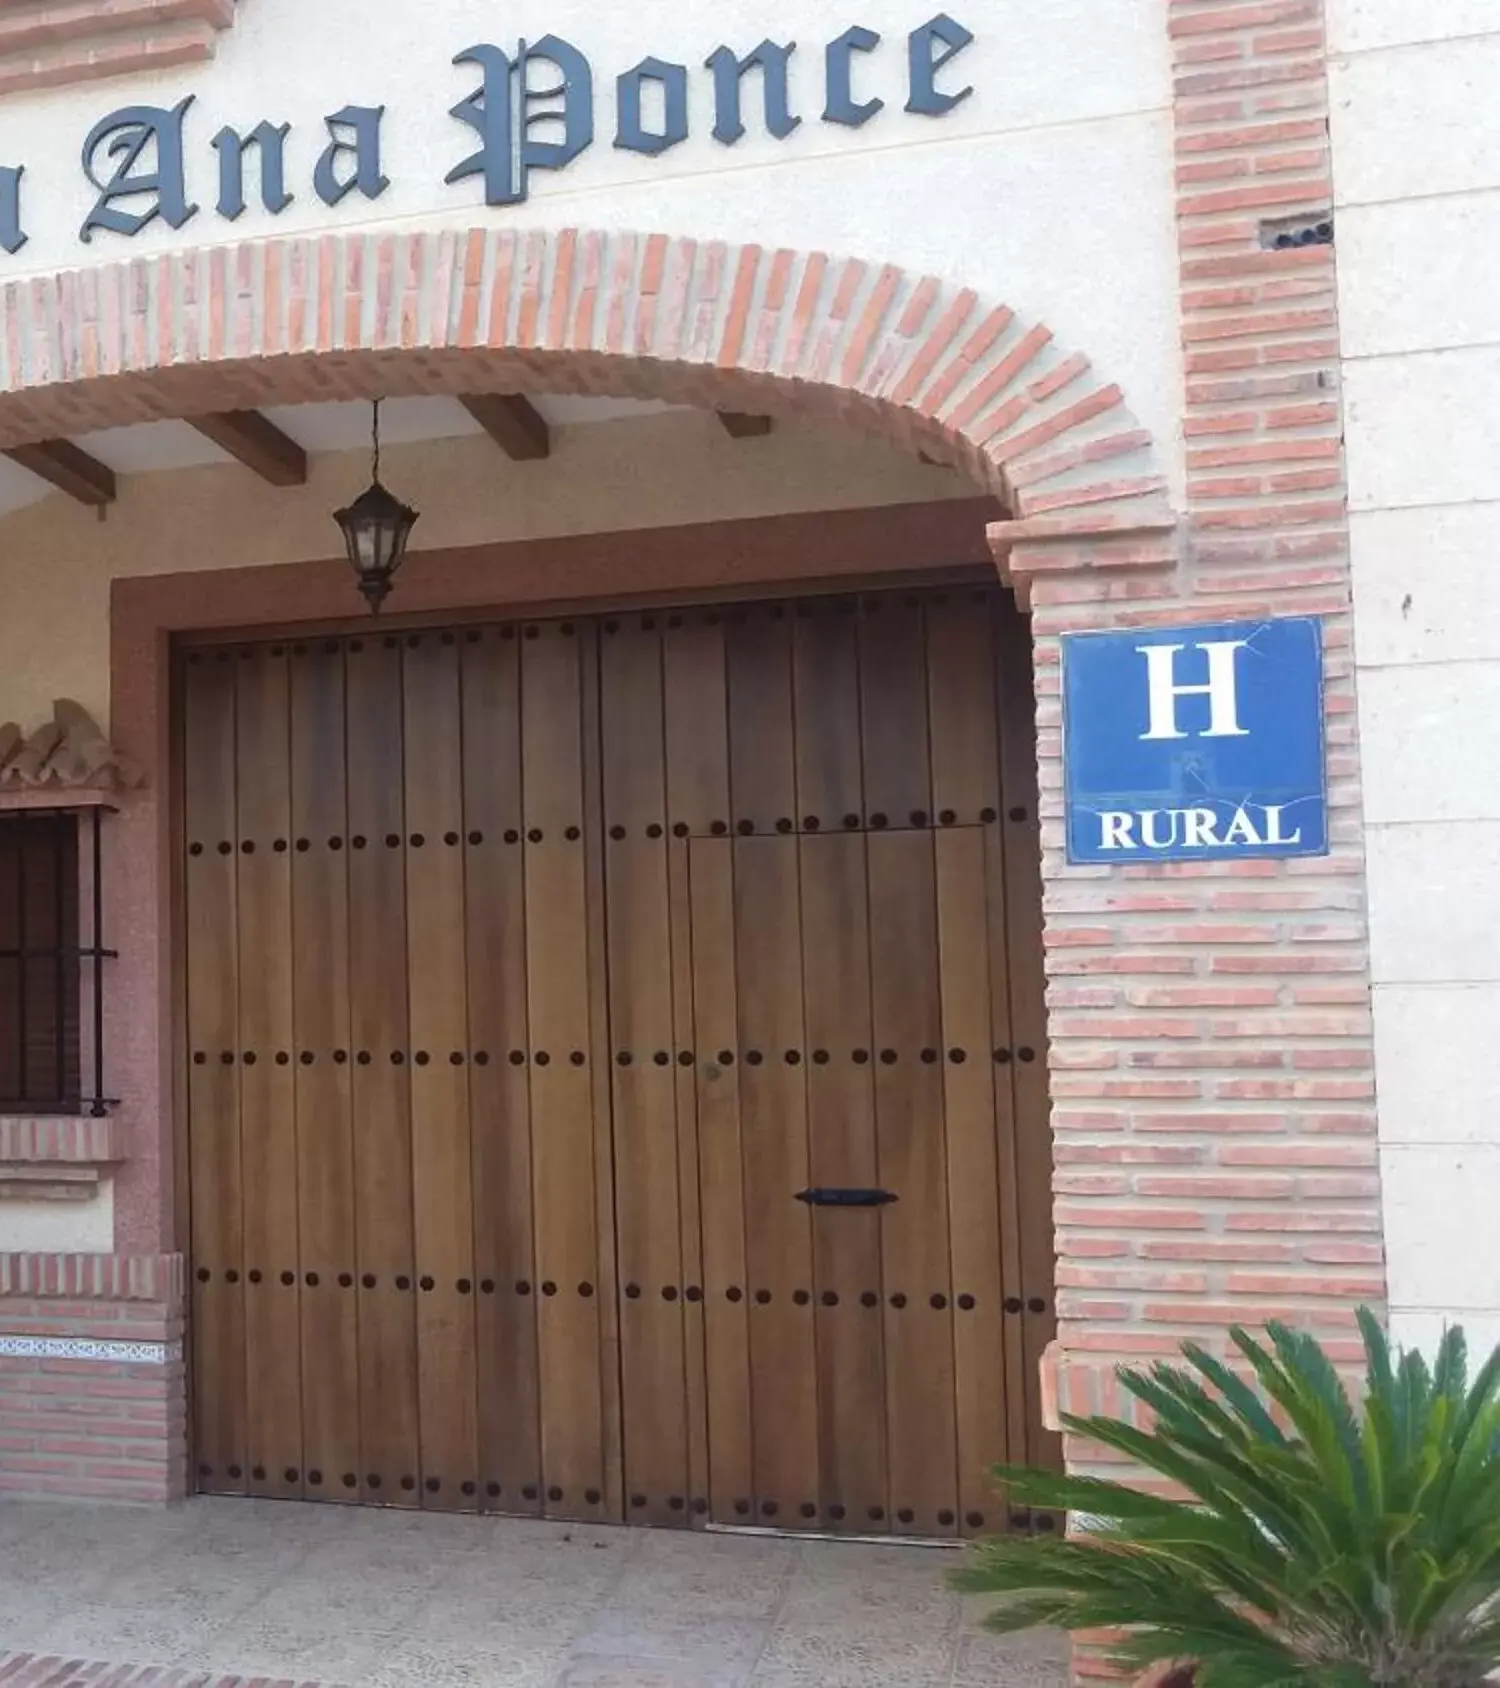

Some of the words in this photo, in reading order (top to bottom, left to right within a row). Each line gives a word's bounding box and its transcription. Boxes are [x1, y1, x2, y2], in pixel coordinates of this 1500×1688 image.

[79, 94, 390, 244] Ana
[444, 13, 975, 207] Ponce
[1135, 640, 1250, 740] H
[1097, 805, 1301, 849] RURAL
